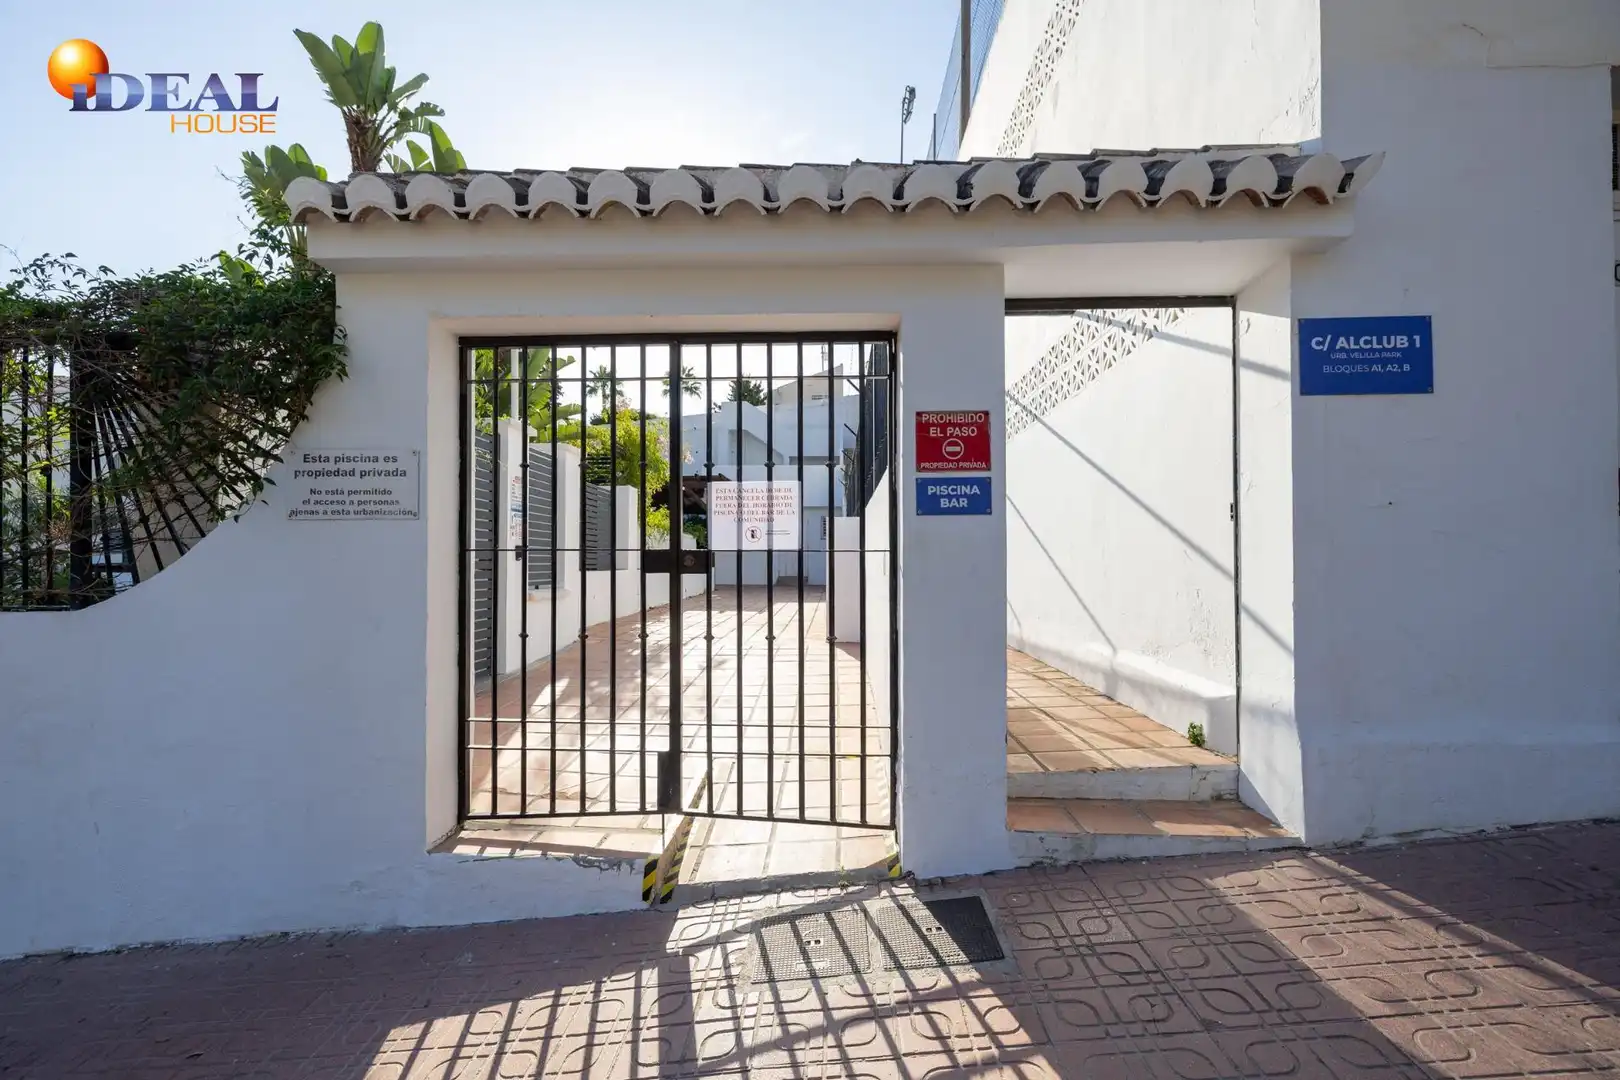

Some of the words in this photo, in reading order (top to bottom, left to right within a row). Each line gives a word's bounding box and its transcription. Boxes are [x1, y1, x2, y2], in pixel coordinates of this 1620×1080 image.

[1311, 334, 1332, 351] C/
[1335, 335, 1409, 350] ALCLUB
[1413, 335, 1421, 348] 1
[1349, 351, 1380, 359] VELILLA
[1323, 364, 1370, 373] BLOQUES
[1371, 364, 1384, 373] A1,
[1386, 364, 1401, 372] A2,
[1403, 363, 1411, 371] B
[921, 412, 985, 424] PROHIBIDO
[929, 426, 944, 437] EL
[946, 426, 978, 437] PASO
[303, 453, 330, 463] Esta
[334, 453, 379, 465] piscina
[383, 455, 398, 463] es
[958, 461, 987, 469] PRIVADA
[294, 467, 356, 479] propiedad
[359, 467, 407, 479] privada
[309, 488, 322, 496] No
[325, 487, 345, 496] está
[347, 487, 393, 497] permitido
[927, 485, 981, 495] PISCINA
[302, 498, 311, 506] el
[357, 499, 400, 507] personas
[940, 498, 968, 508] BAR
[290, 508, 320, 517] ajenas
[331, 508, 351, 516] esta
